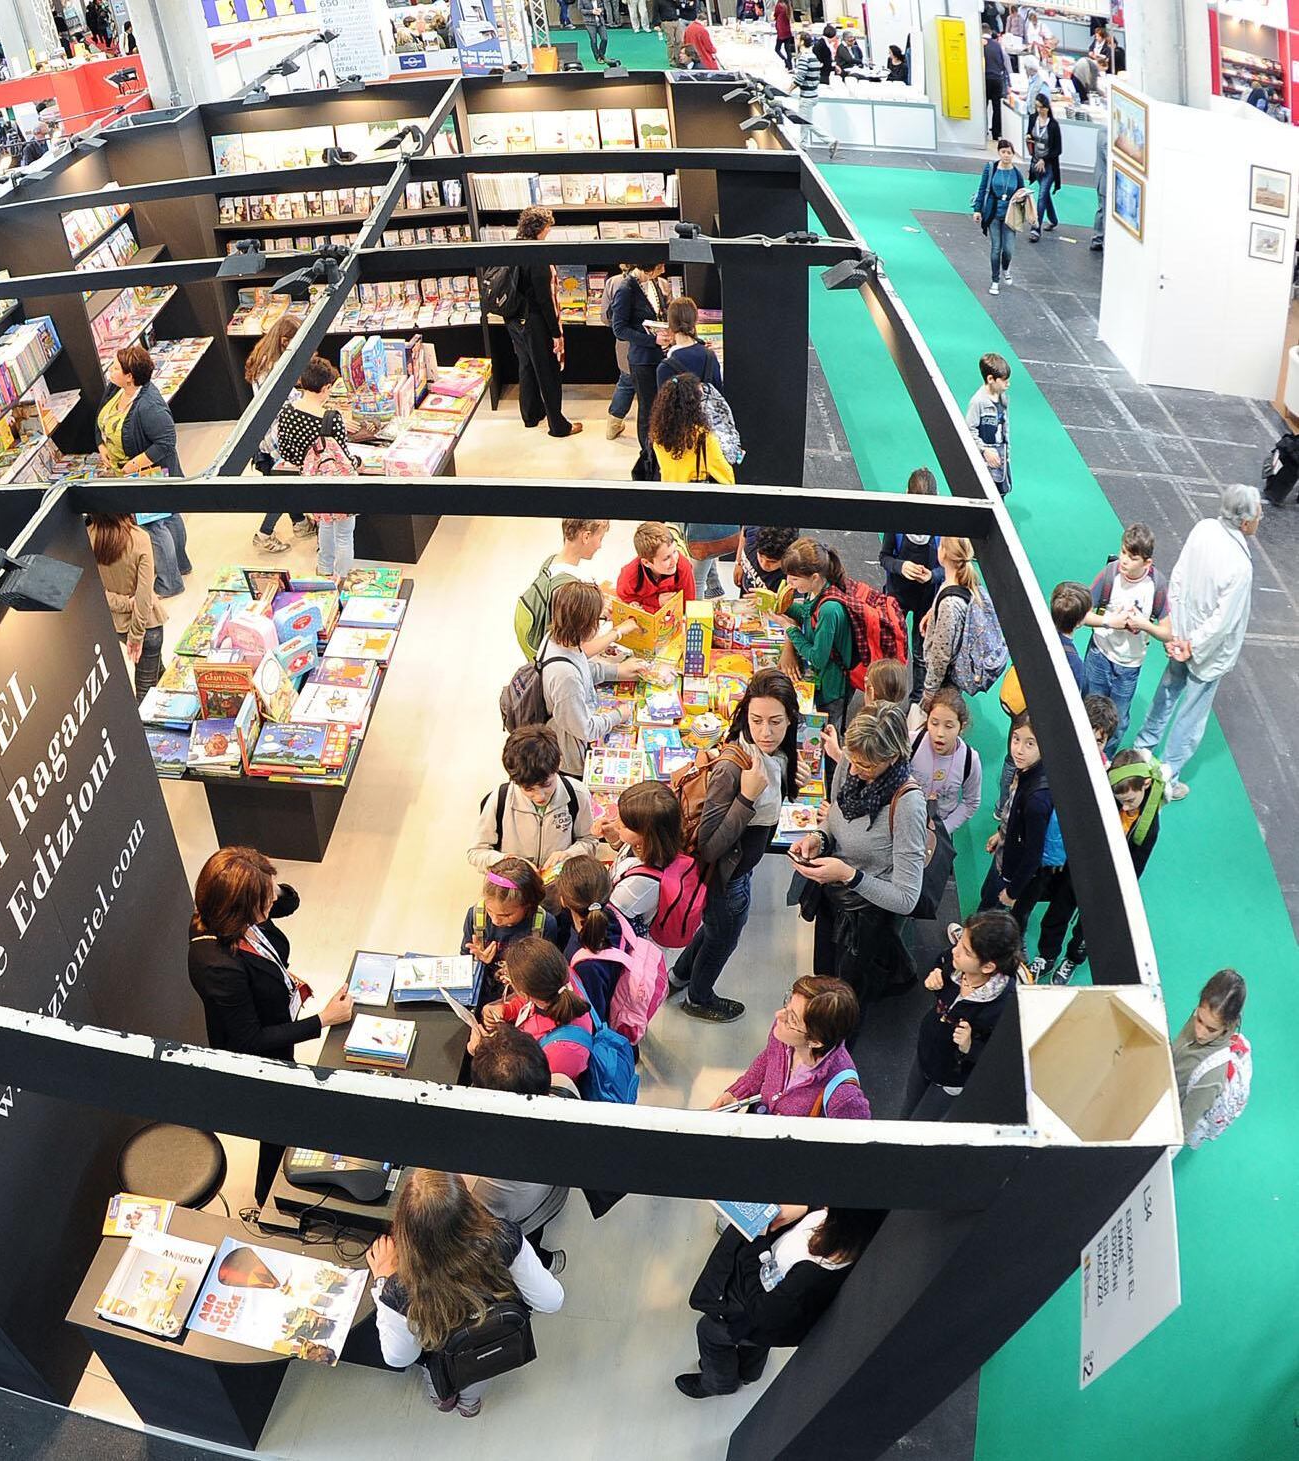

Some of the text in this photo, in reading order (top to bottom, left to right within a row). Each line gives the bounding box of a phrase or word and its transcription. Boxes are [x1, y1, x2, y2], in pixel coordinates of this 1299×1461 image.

[5, 642, 116, 836] Ragazzi
[5, 726, 119, 941] Edizioni
[1143, 1184, 1153, 1222] L34
[162, 1249, 204, 1265] ANDERSEN
[1101, 1234, 1110, 1298] EINAUDI
[1110, 1224, 1119, 1293] EDIZIONI
[1116, 1217, 1125, 1265] EMME
[1125, 1207, 1136, 1301] EDIZIONI EL
[1096, 1240, 1104, 1308] RAGAZZI
[198, 1293, 217, 1321] AMO
[1082, 1361, 1094, 1382] 2
